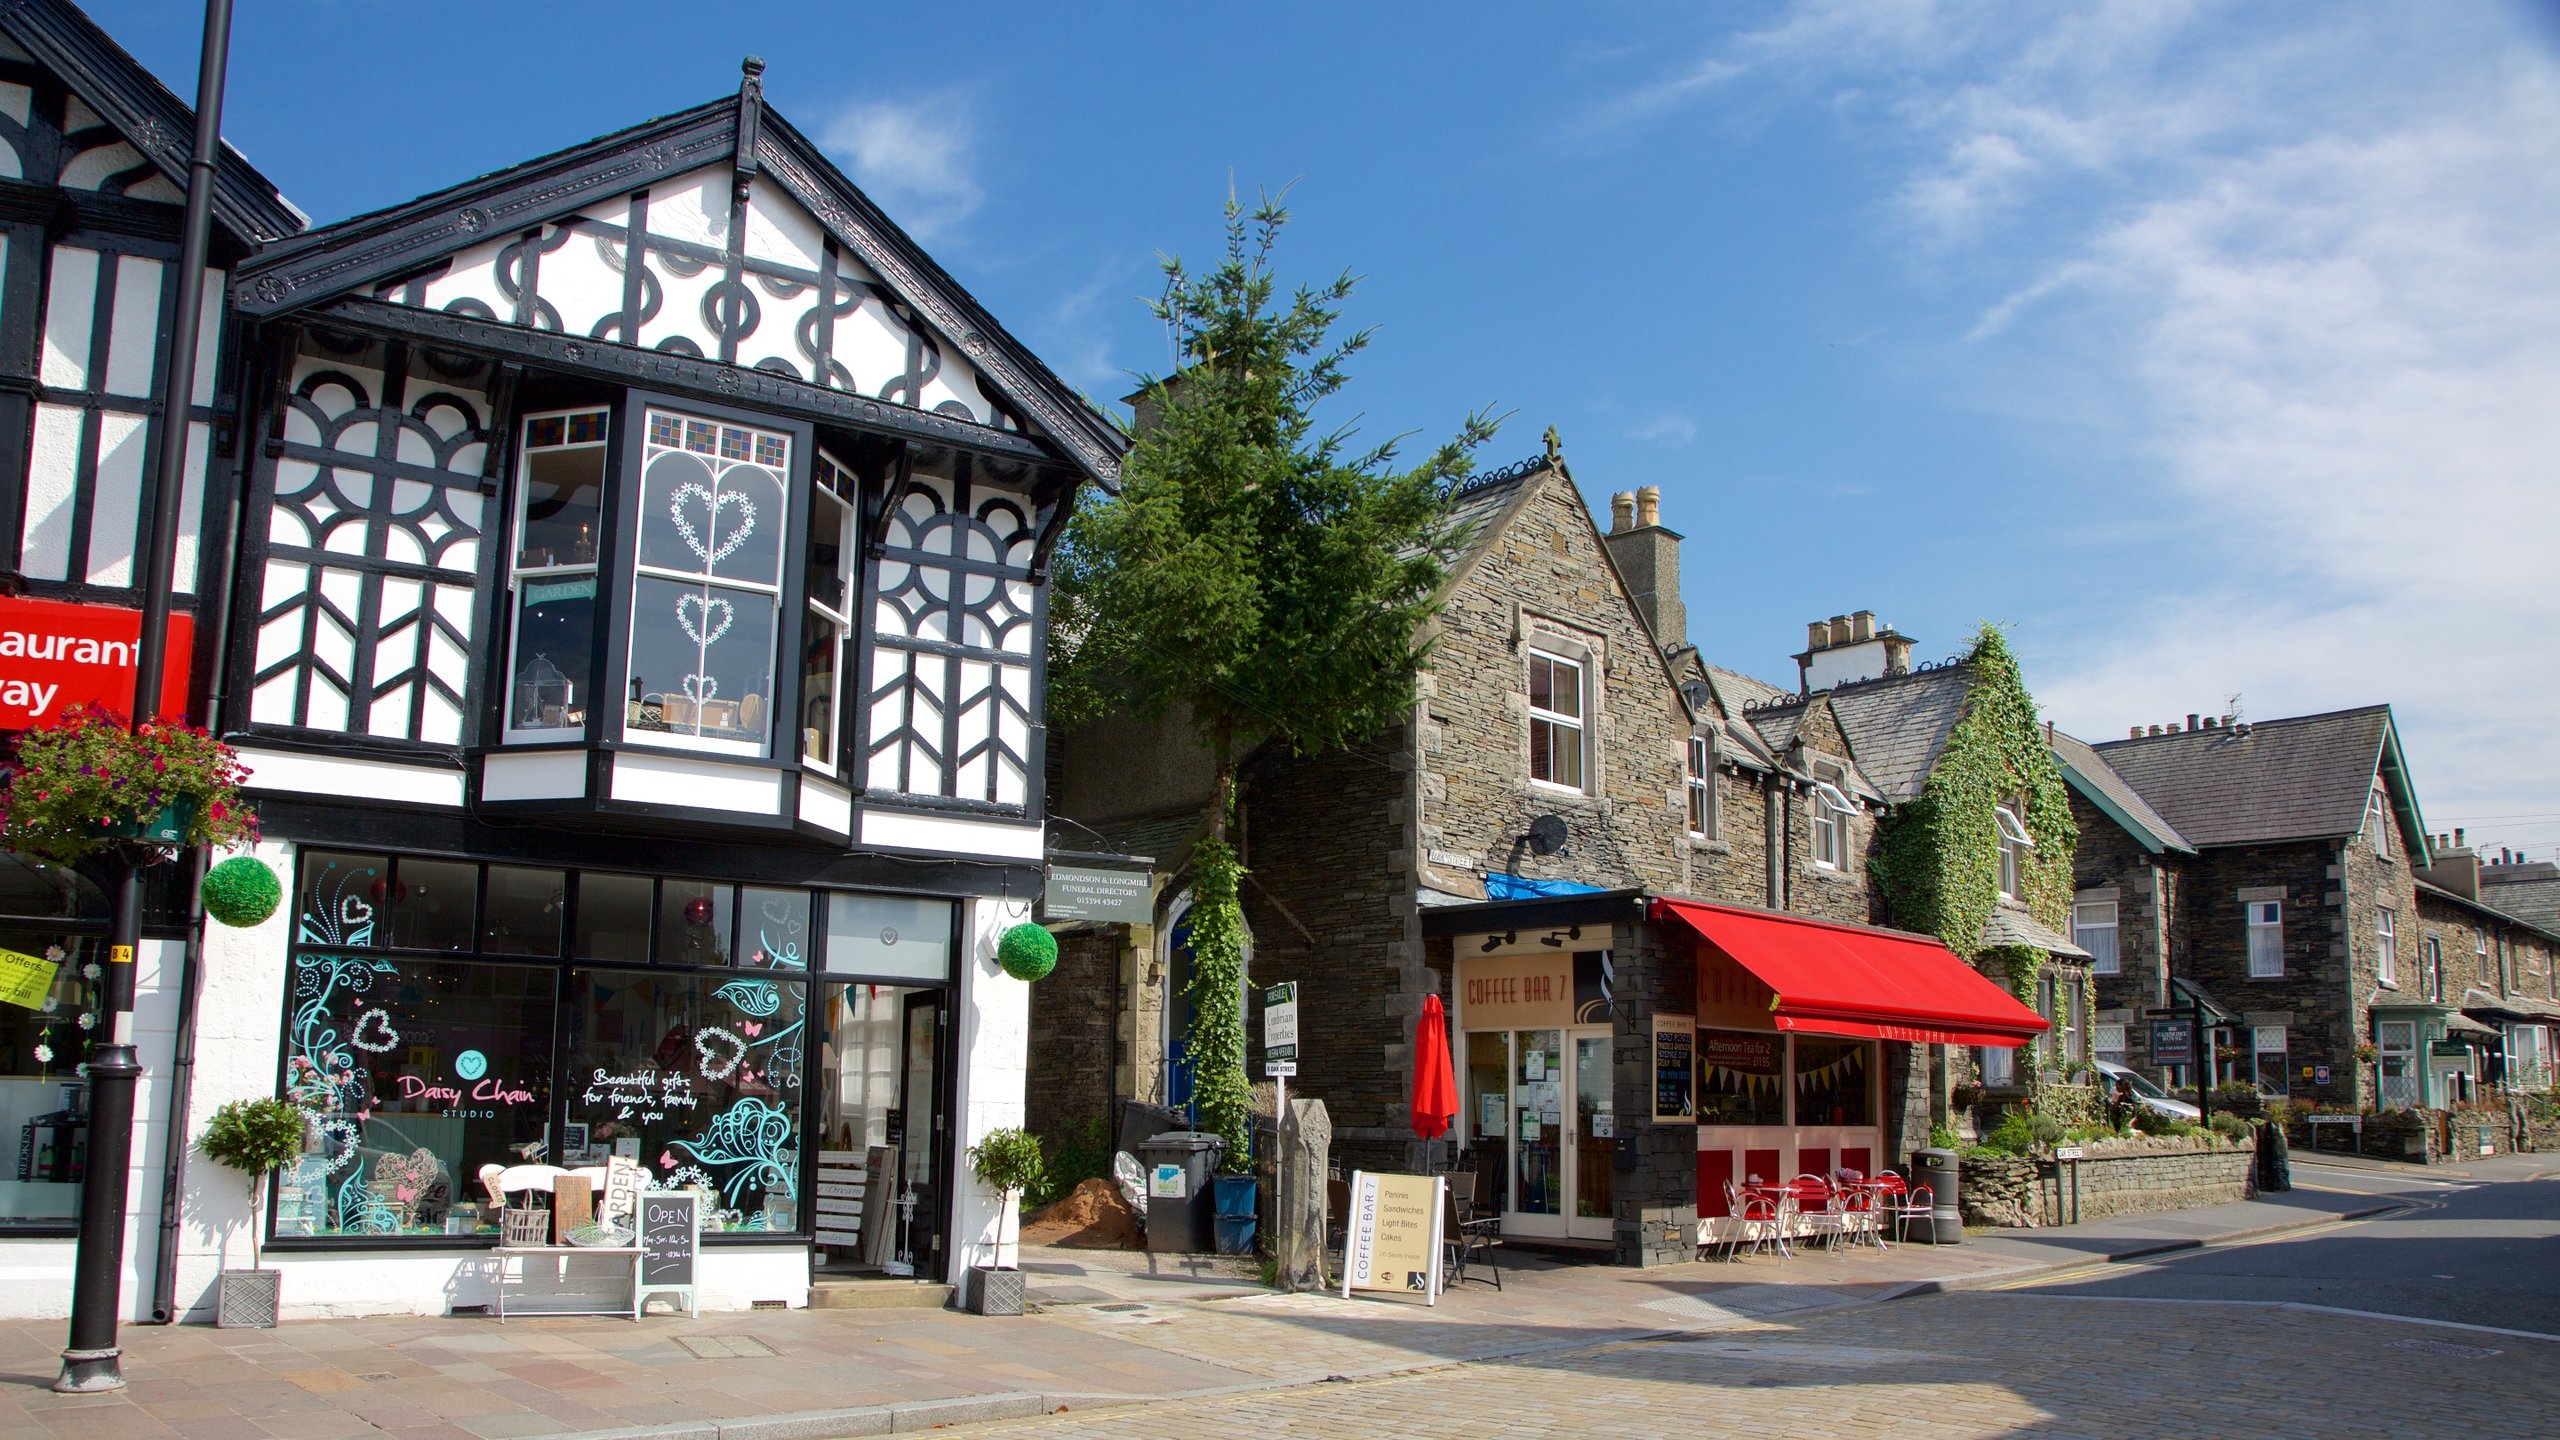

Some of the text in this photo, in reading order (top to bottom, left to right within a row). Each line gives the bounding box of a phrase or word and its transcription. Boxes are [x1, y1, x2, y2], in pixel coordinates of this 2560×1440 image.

[535, 583, 592, 599] GARDEN
[0, 680, 58, 716] ay
[1051, 873, 1100, 883] EDMONDSON
[1109, 877, 1148, 887] LONGMIRE
[1062, 885, 1137, 897] FUNERAL DIRECTORS
[1077, 896, 1100, 905] 015394
[14, 989, 32, 1000] bill
[1468, 975, 1567, 1005] COFFEE BAR 7
[1267, 1008, 1294, 1026] Cumbrian
[1267, 1026, 1294, 1044] Properties
[1709, 1040, 1771, 1054] Afternoon Tea for 2
[1280, 1064, 1295, 1072] STREET
[593, 1068, 691, 1090] Beautiful gifts
[397, 1075, 535, 1107] Daisy Chain
[582, 1087, 697, 1110] for friends, family
[442, 1110, 494, 1119] STUDIO
[617, 1106, 663, 1125] & you
[20, 1127, 31, 1175] REDKEN
[1385, 1190, 1409, 1199] Paninis
[648, 1204, 690, 1224] OPEN
[1363, 1195, 1374, 1221] BAR
[1383, 1205, 1424, 1215] Sandwiches
[1382, 1219, 1418, 1229] Light Bites
[1381, 1233, 1402, 1242] Cakes
[1358, 1226, 1372, 1279] COFFEE
